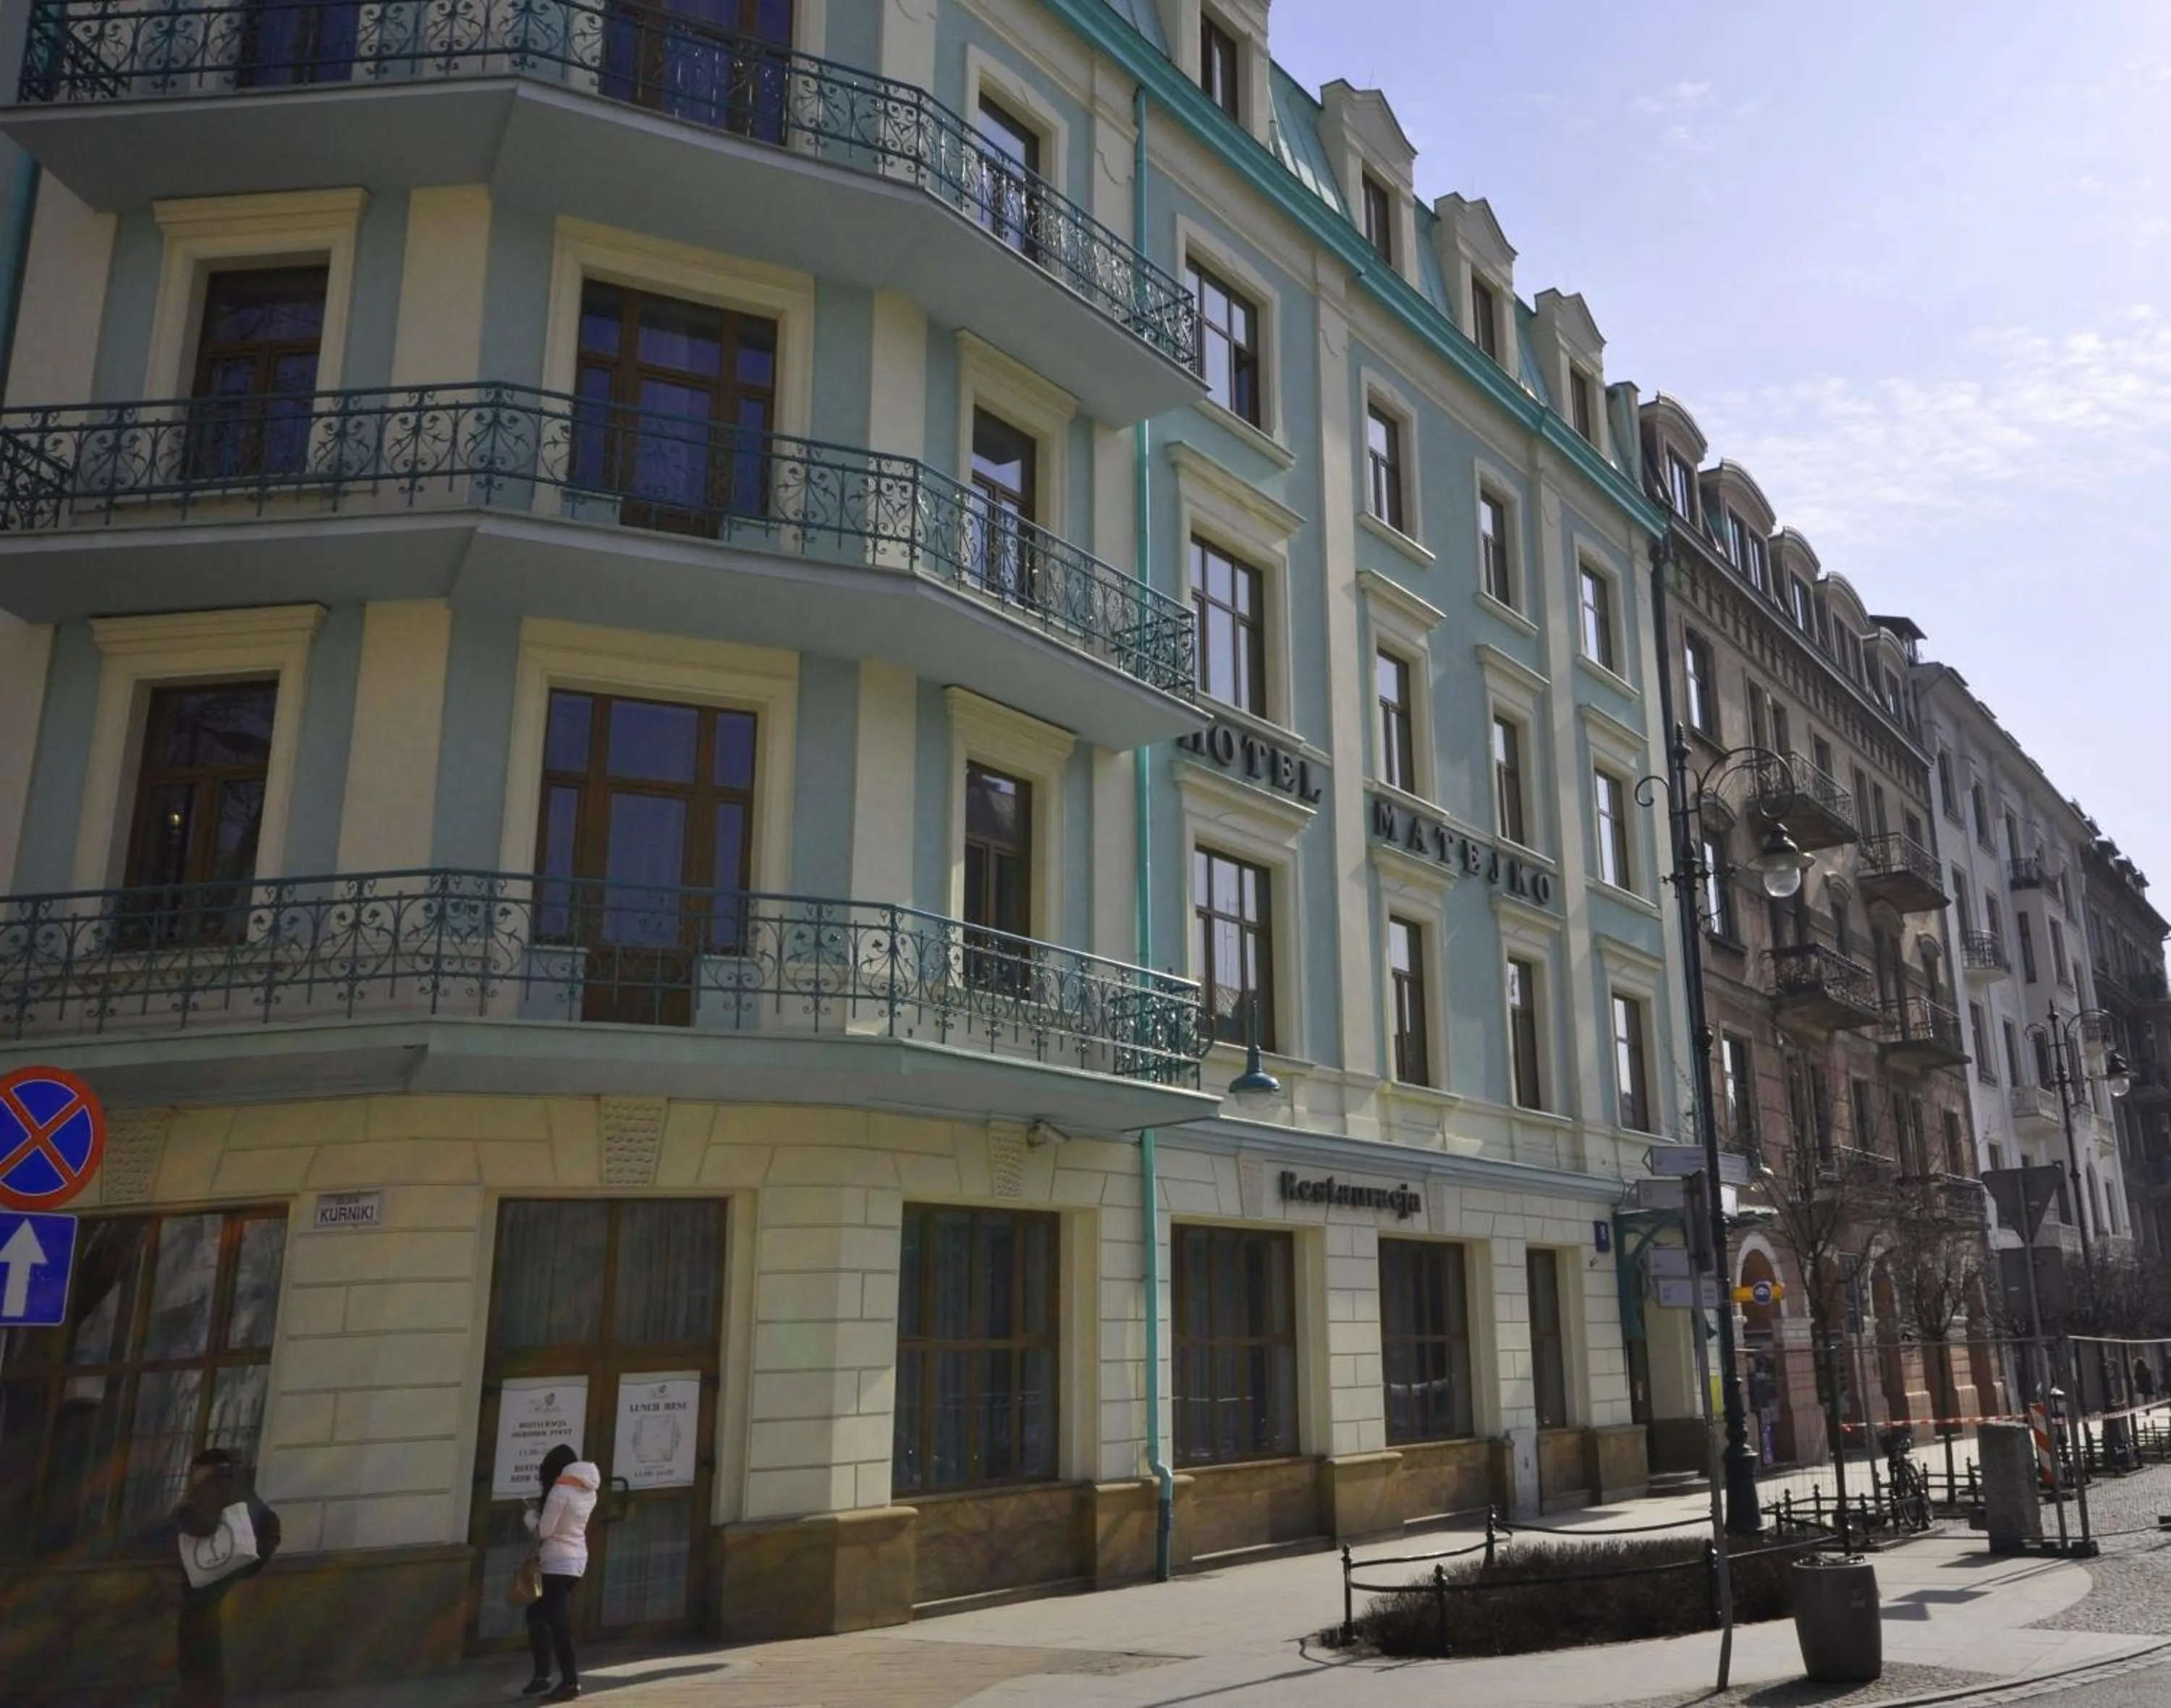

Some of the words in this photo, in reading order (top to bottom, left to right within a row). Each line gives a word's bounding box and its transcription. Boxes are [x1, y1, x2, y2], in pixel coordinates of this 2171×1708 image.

[1373, 799, 1552, 905] MATEJKO
[320, 1204, 374, 1223] KURNIKI
[1277, 1170, 1422, 1220] Restauracja
